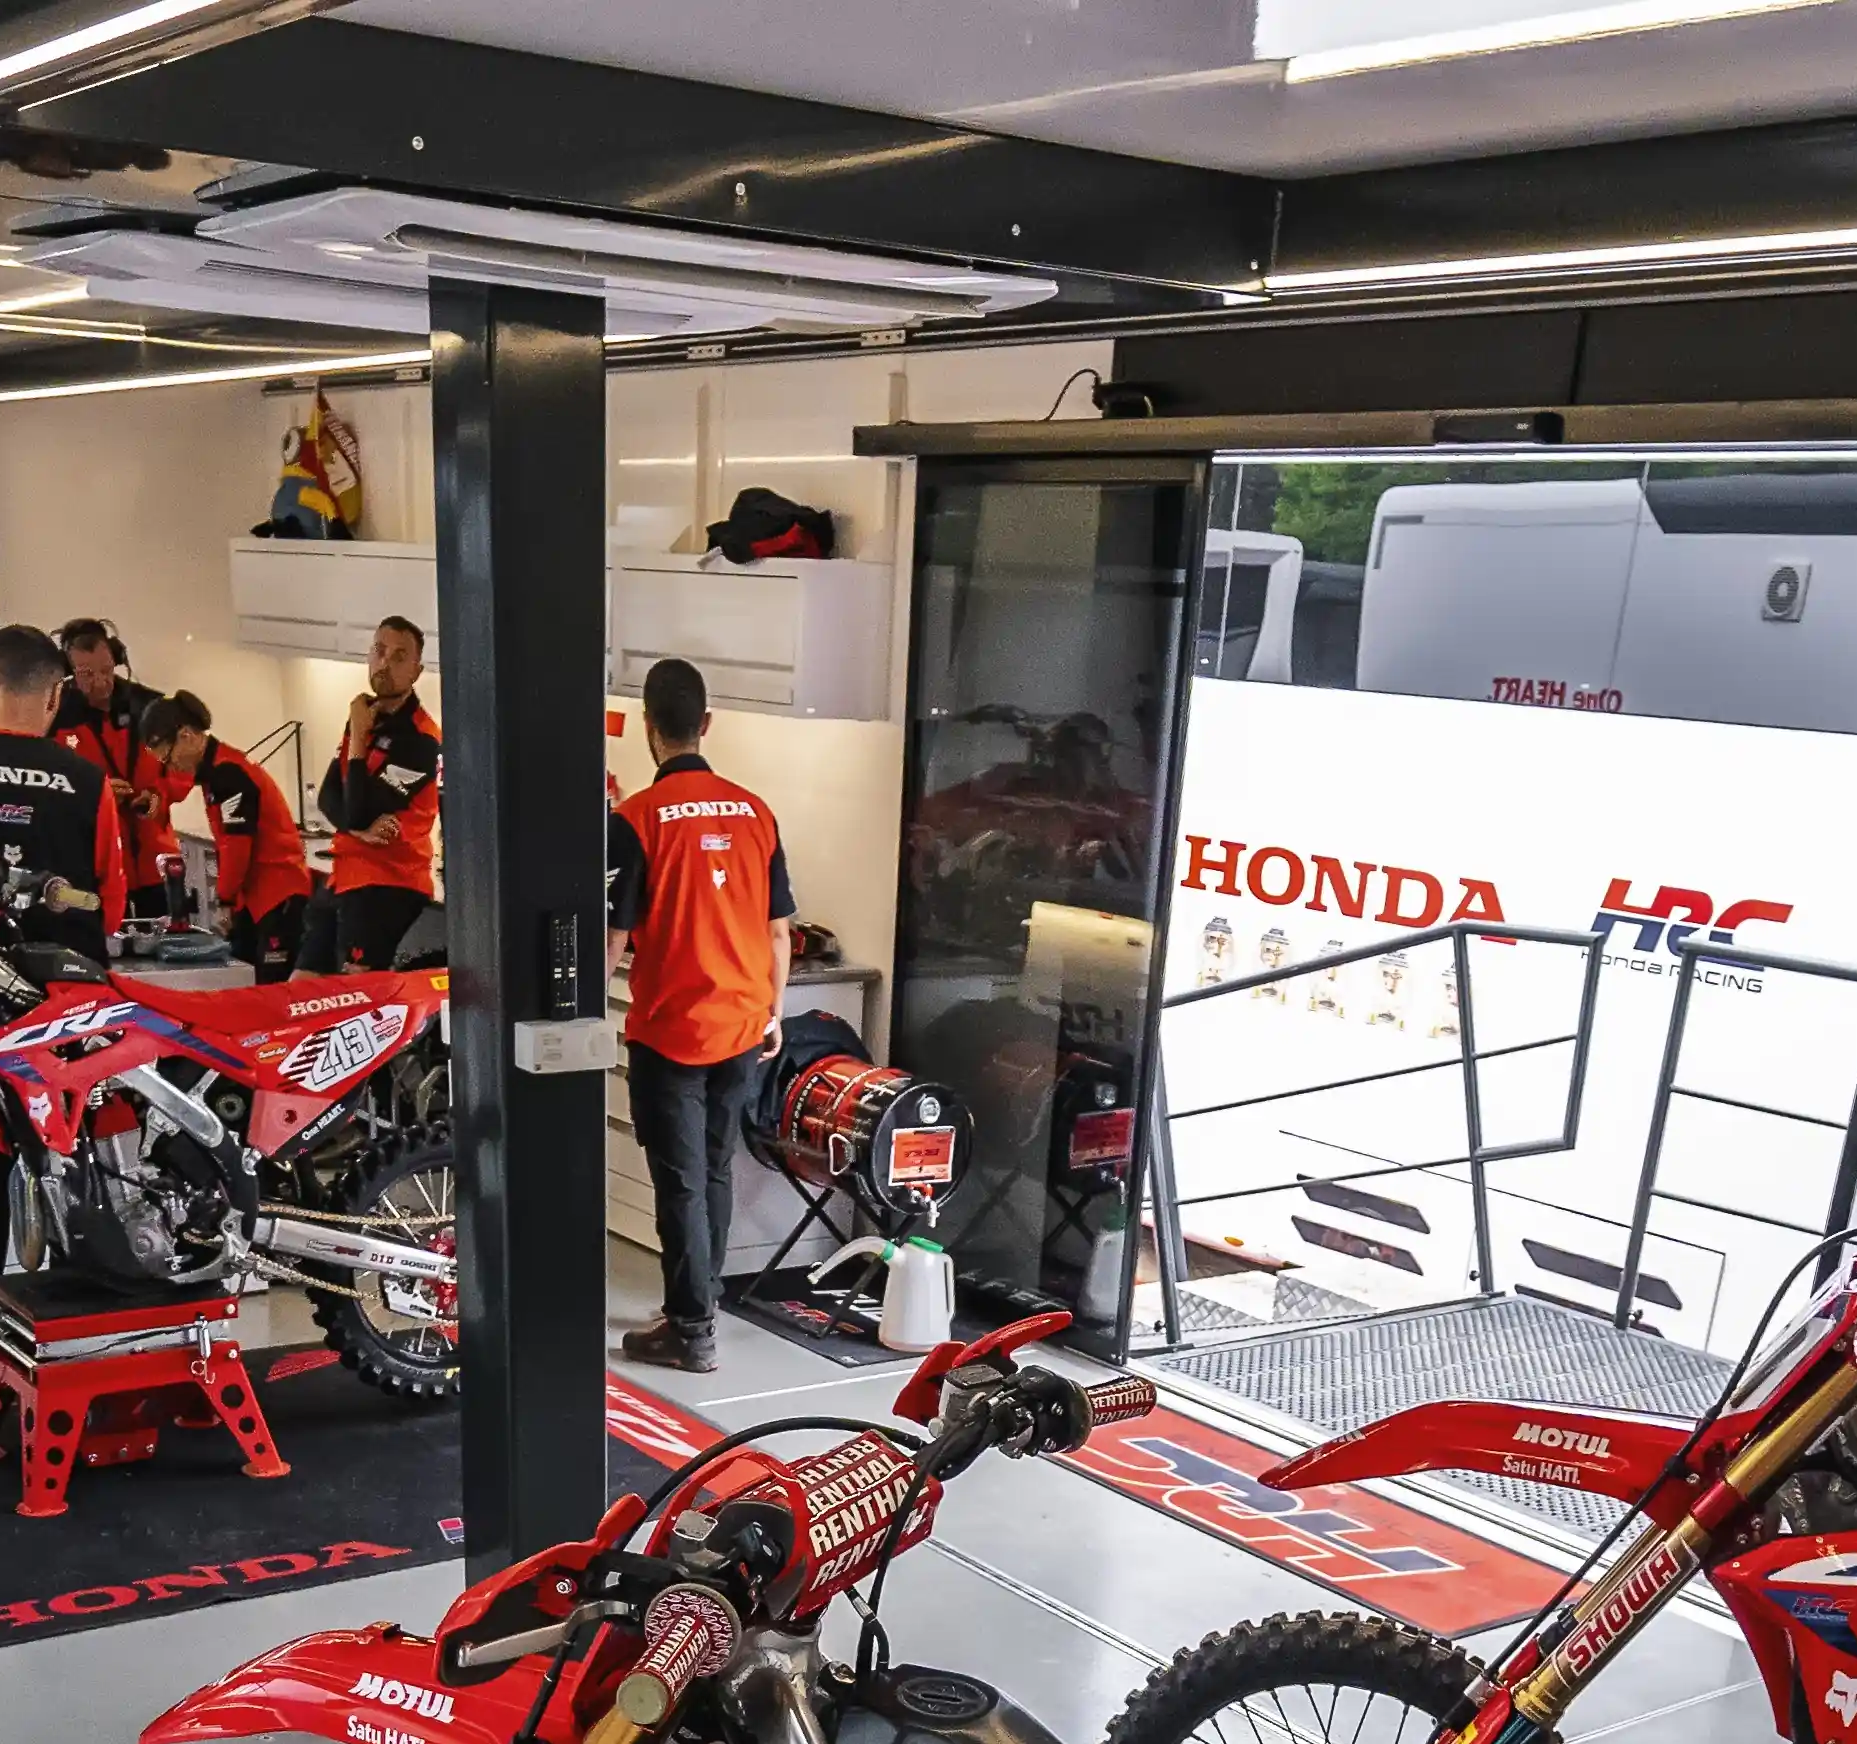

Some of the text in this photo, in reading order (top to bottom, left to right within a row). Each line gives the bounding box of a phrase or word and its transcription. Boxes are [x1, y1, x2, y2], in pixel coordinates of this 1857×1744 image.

[657, 801, 756, 823] HONDA
[1180, 834, 1517, 945] HONDA
[1590, 878, 1794, 972] HRC
[288, 992, 372, 1017] HONDA
[1502, 1455, 1536, 1476] Satu
[1512, 1422, 1611, 1458] MOTUL
[1054, 1437, 1465, 1581] HRC
[1567, 1542, 1682, 1677] SHOWA
[349, 1672, 455, 1724] MOTUL
